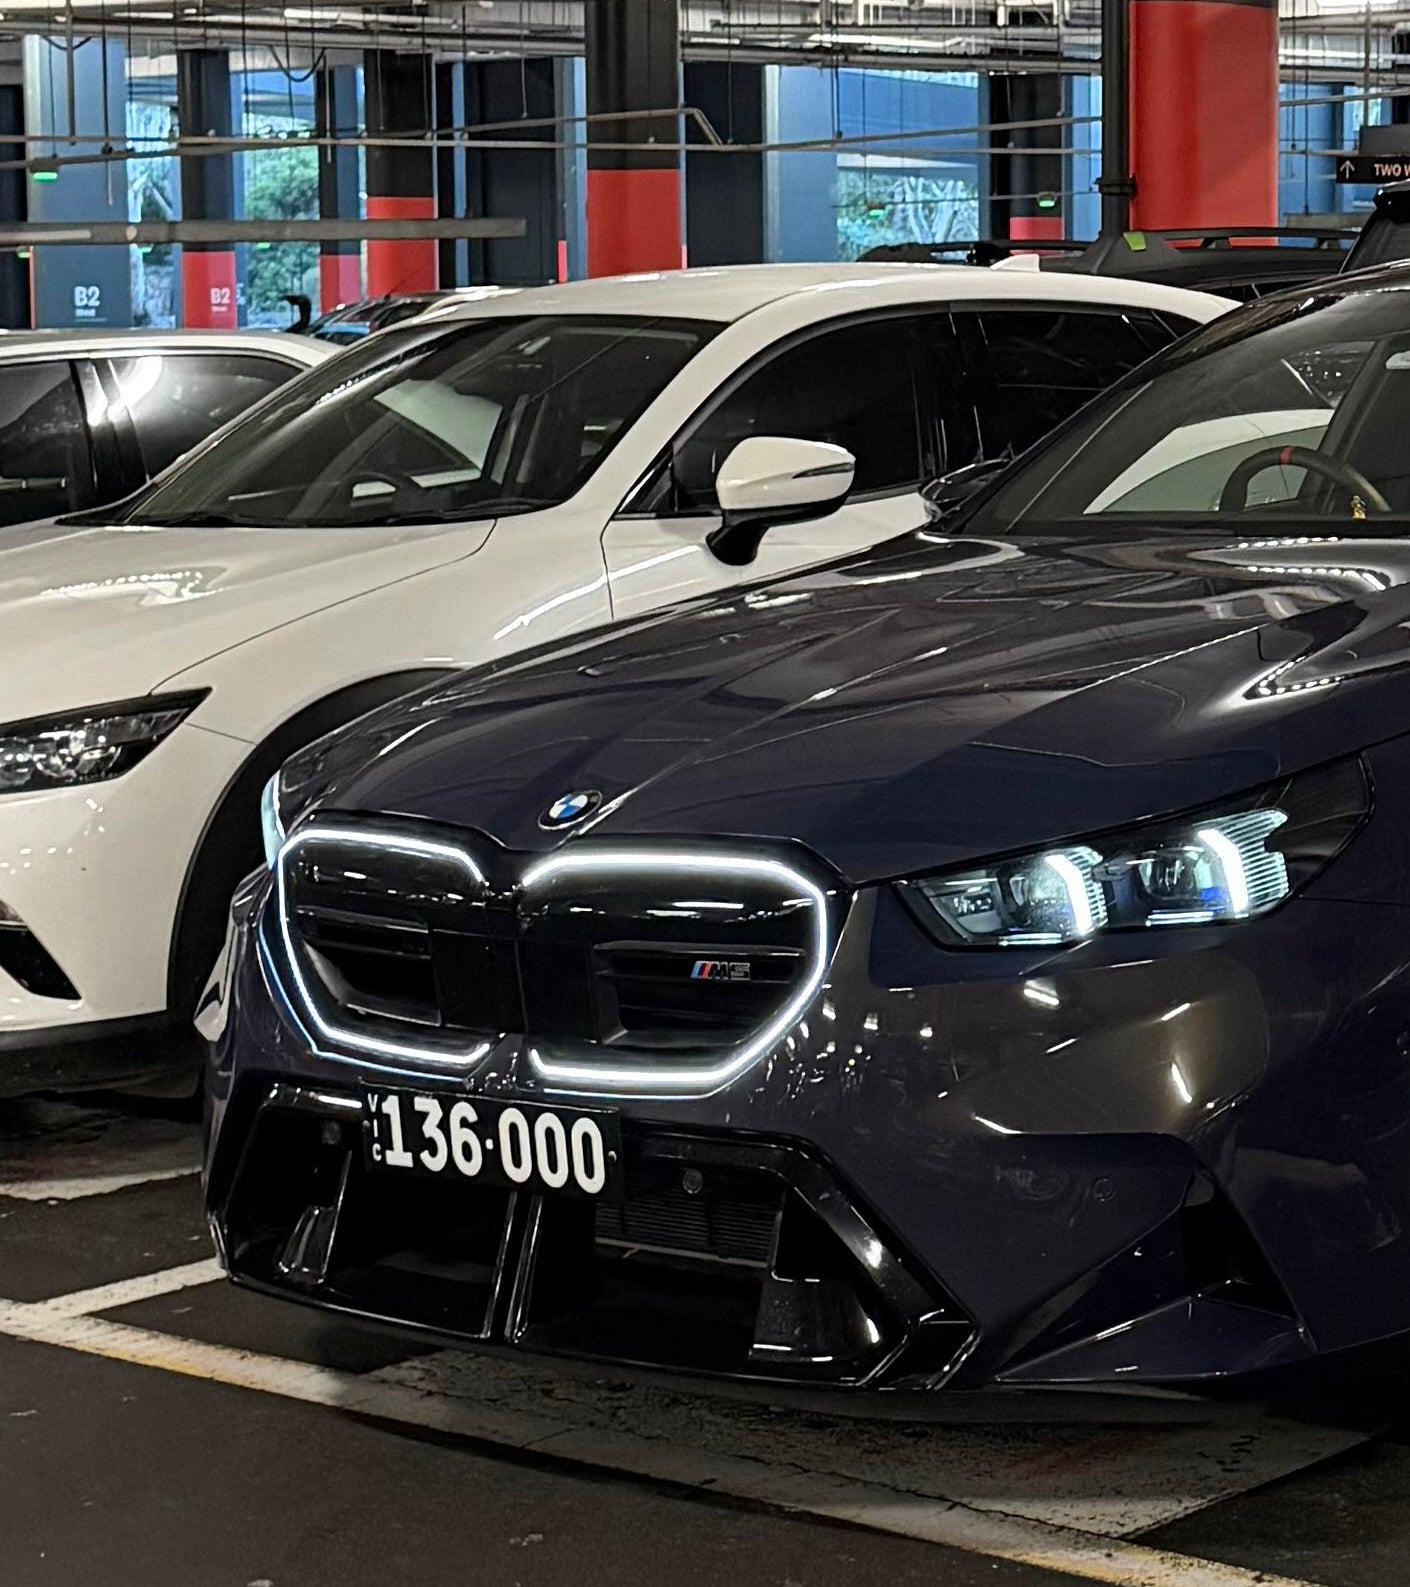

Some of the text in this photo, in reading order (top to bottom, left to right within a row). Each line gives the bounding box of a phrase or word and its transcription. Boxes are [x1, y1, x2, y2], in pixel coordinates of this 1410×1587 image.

[1374, 164, 1401, 177] TWO
[74, 286, 100, 307] B2
[211, 288, 230, 304] B2
[367, 1093, 382, 1162] VIC
